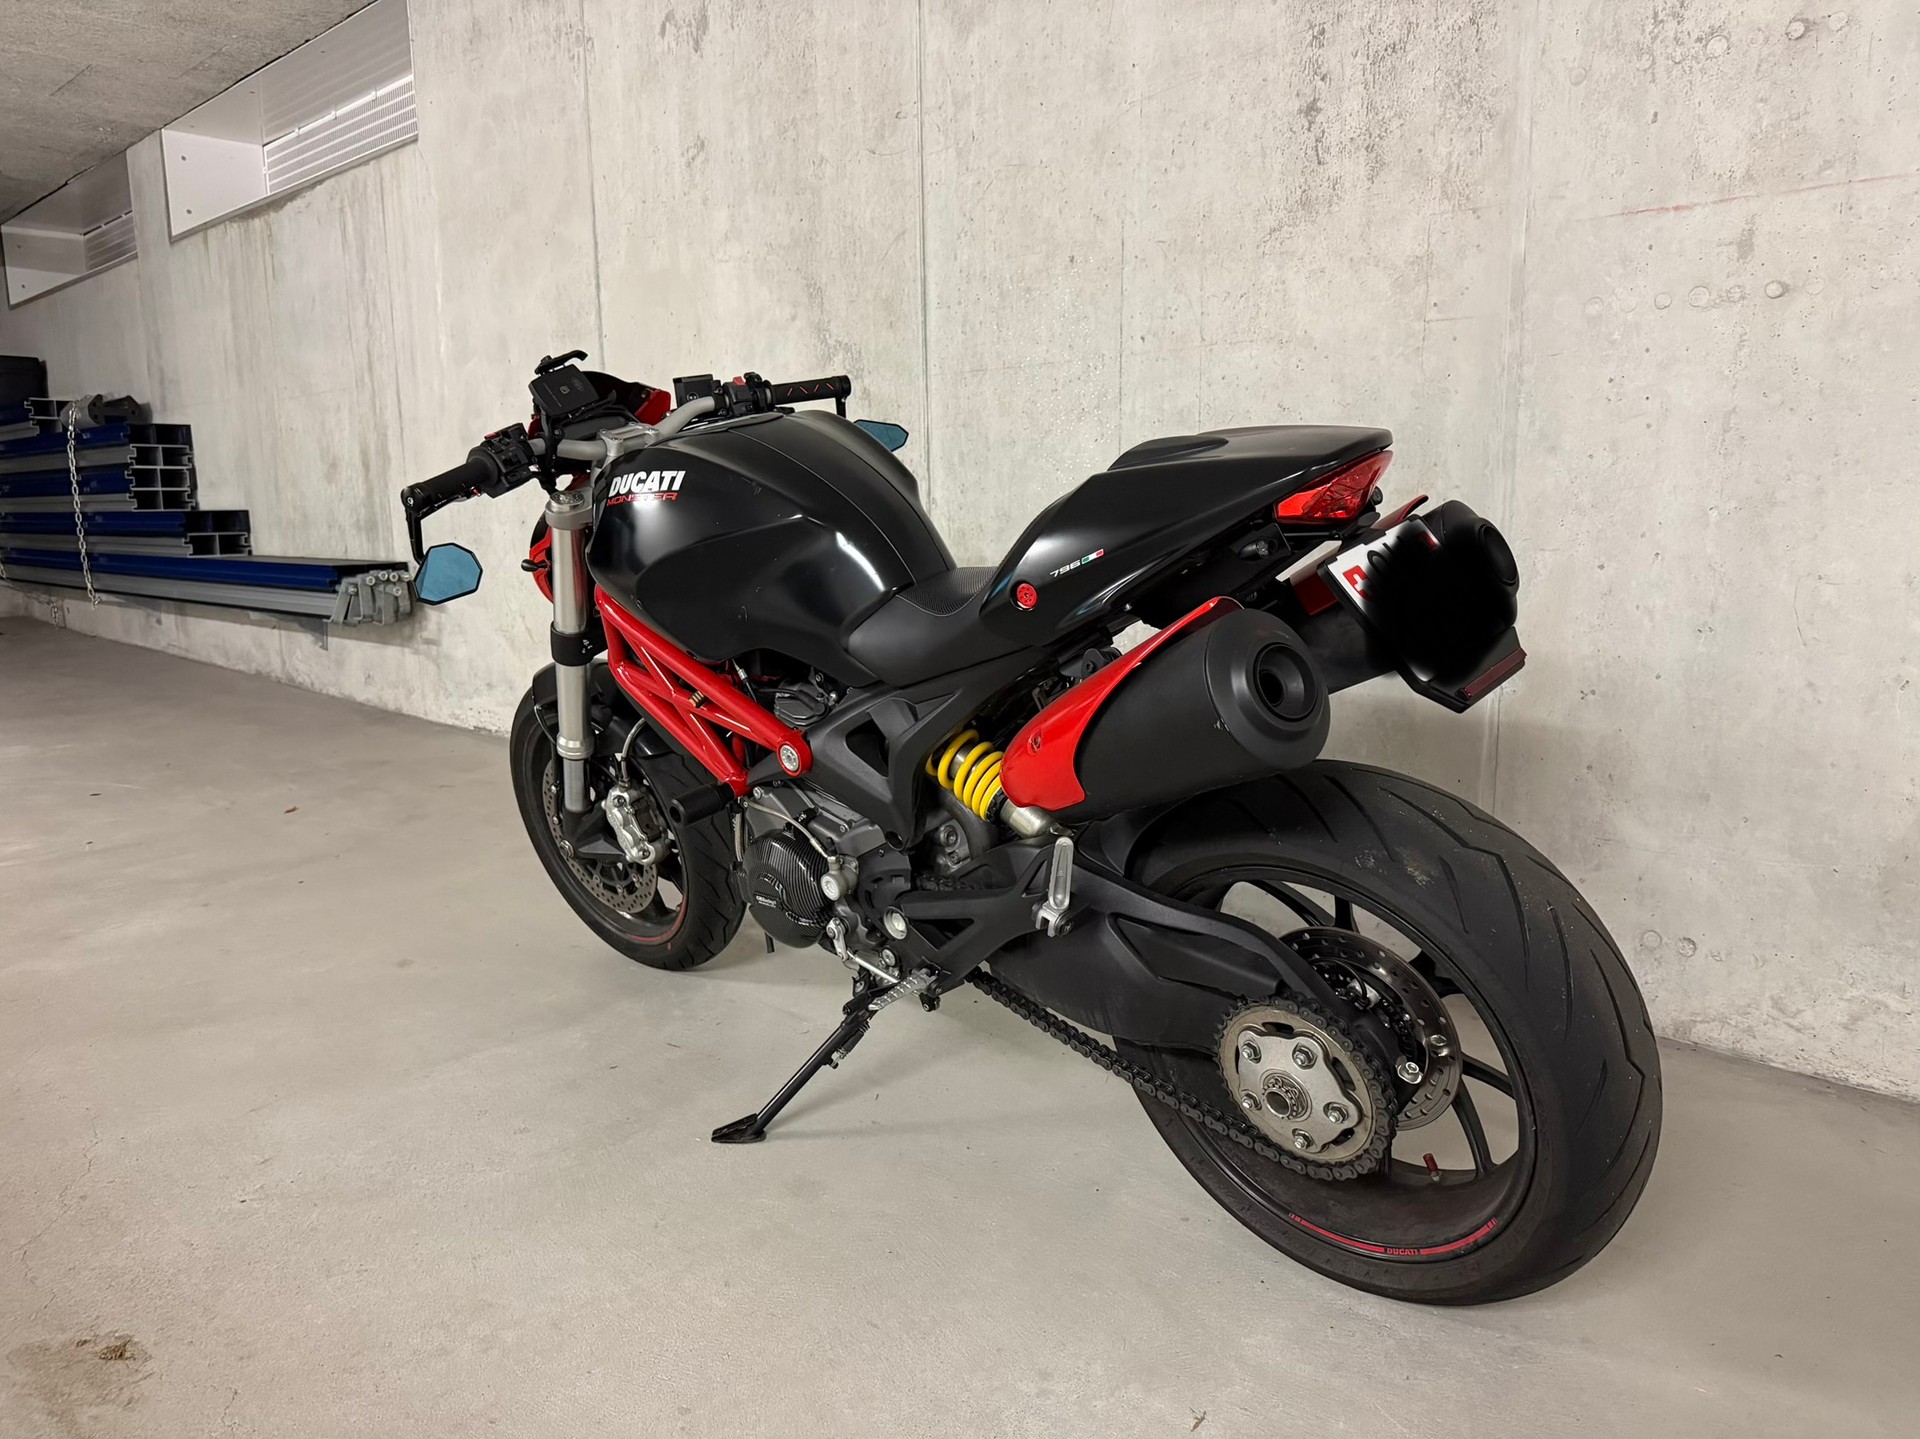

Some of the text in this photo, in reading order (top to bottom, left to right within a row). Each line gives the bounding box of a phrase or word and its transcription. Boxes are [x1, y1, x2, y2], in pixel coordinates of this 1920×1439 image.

[608, 470, 686, 498] DUCATI
[1050, 560, 1081, 578] 796
[1387, 1247, 1418, 1256] DUCATI
